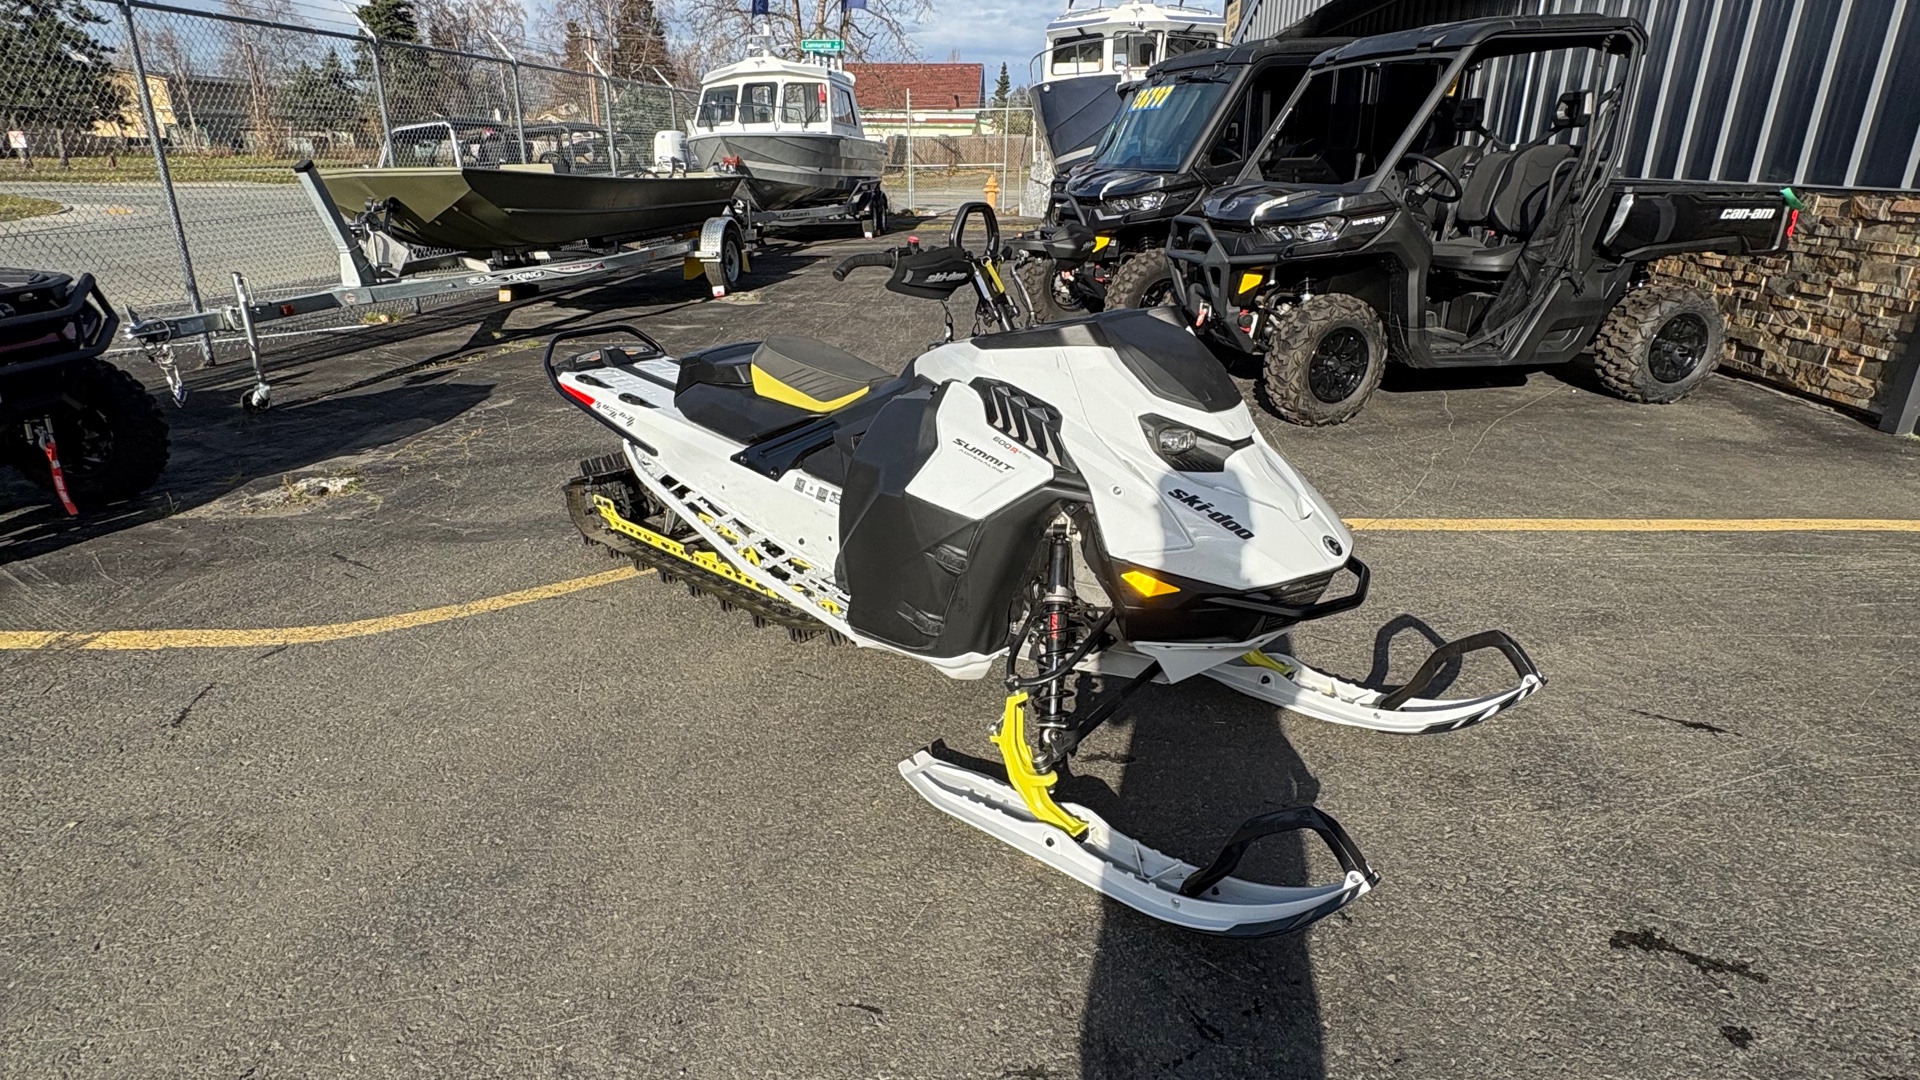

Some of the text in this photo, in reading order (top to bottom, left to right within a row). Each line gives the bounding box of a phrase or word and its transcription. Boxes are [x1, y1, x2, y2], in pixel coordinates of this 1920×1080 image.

[1352, 216, 1387, 226] DEFENDER
[1720, 208, 1776, 220] can-am
[925, 271, 968, 283] ski-doo
[992, 436, 1019, 454] 600R
[952, 438, 1016, 471] SUMMIT
[958, 448, 1005, 474] ADRENALINE
[1167, 488, 1255, 540] ski-doo
